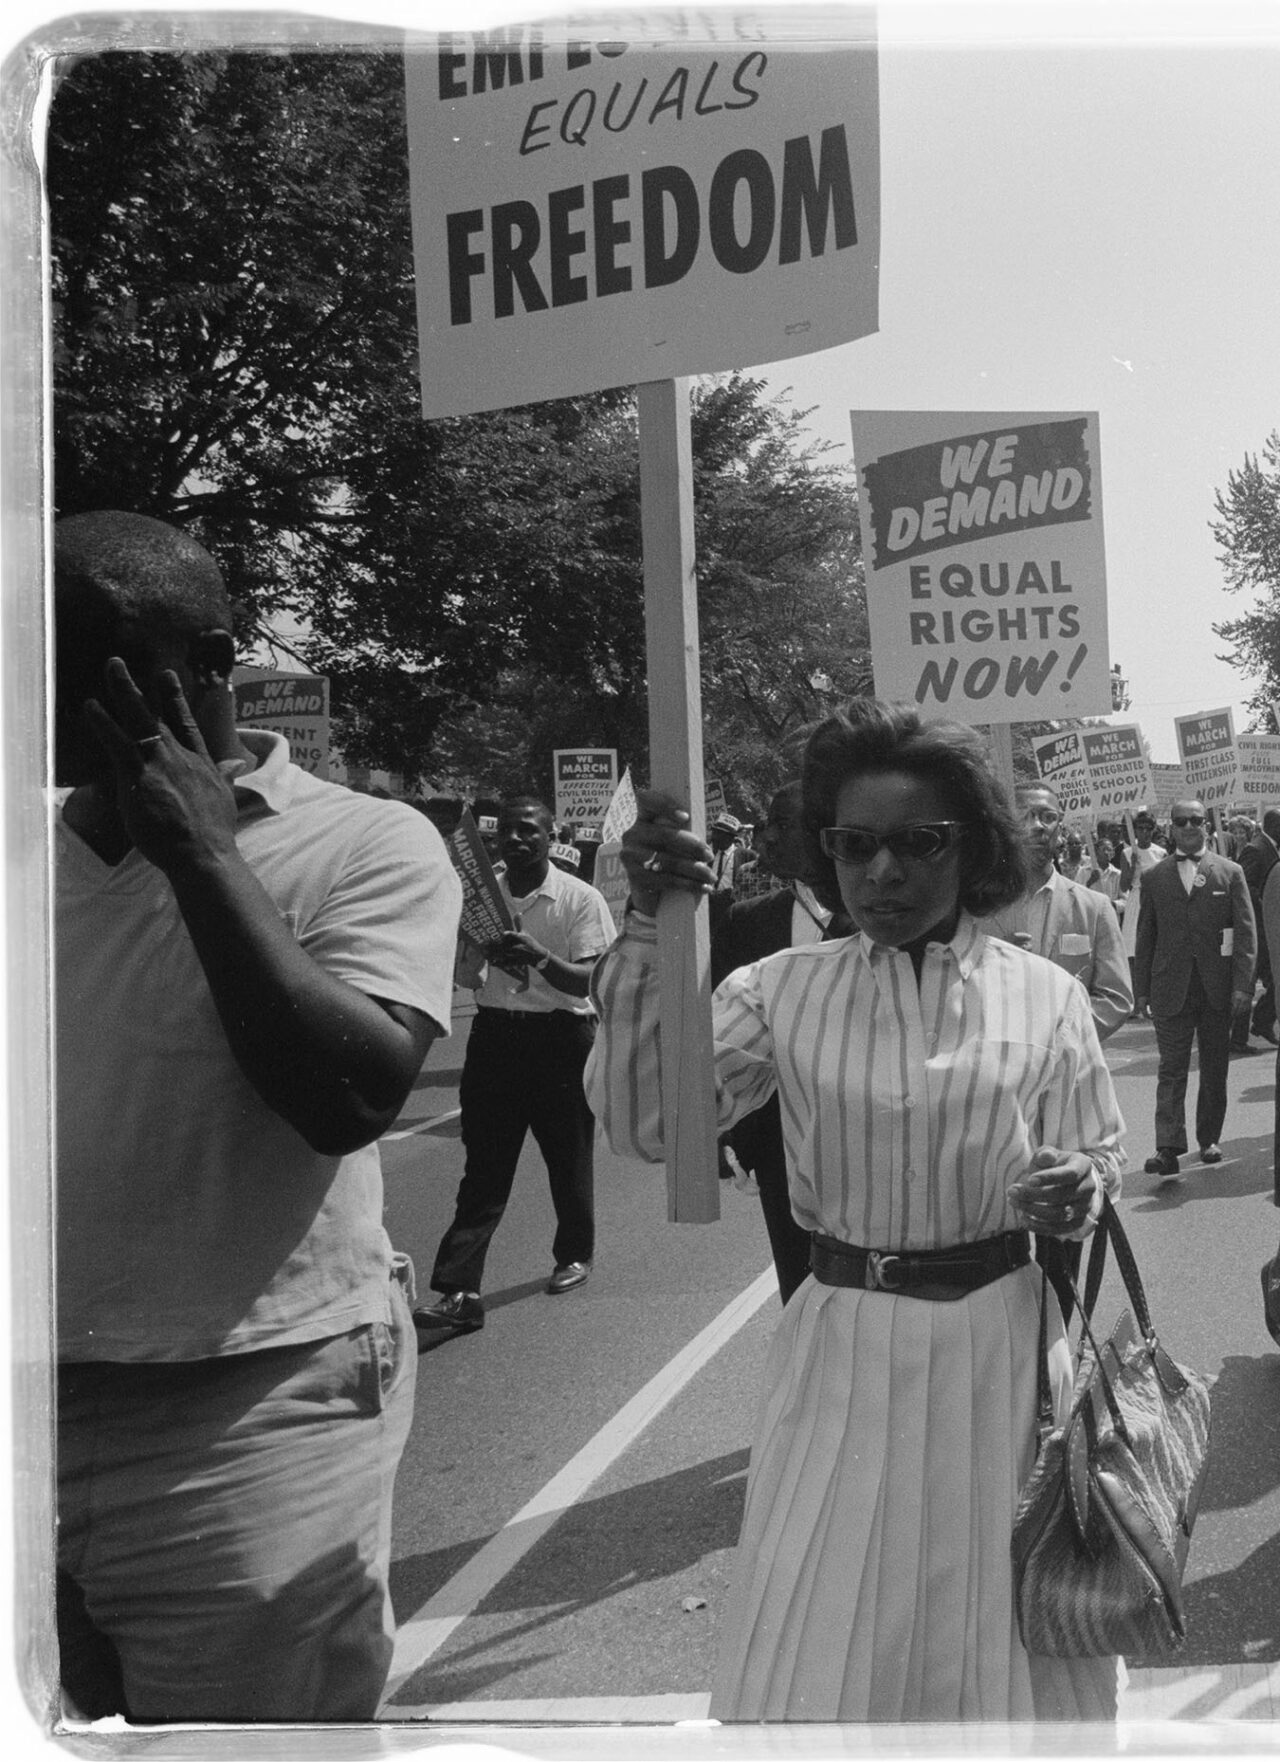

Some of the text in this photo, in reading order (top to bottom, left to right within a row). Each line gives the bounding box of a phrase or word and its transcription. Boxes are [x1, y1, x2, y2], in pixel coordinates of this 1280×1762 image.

[519, 51, 768, 156] EQUALS
[446, 123, 859, 326] FREEDOM
[939, 434, 1019, 489] WE
[886, 466, 1084, 551] DEMAND
[909, 560, 1072, 599] EQUAL
[909, 604, 1080, 646] RIGHTS
[914, 642, 1089, 704] NOW!
[263, 680, 296, 698] WE
[241, 695, 321, 718] DEMAND
[250, 724, 316, 741] CENT
[1198, 719, 1213, 731] WE
[1054, 735, 1077, 754] WE
[1101, 733, 1120, 743] WE
[1186, 727, 1228, 747] MARCH
[1238, 741, 1257, 750] CIVIL
[1089, 740, 1136, 757] MARCH
[1200, 742, 1216, 752] FOR
[576, 755, 594, 763] WE
[1105, 753, 1124, 761] FOR
[1185, 756, 1209, 772] FIRST
[1210, 751, 1235, 766] CLASS
[562, 763, 609, 774] MARCH
[1050, 771, 1067, 782] AN
[1089, 760, 1144, 778] INTEGRATED
[1185, 763, 1238, 785] CITIZENSHIP
[562, 782, 610, 790] EFFECTIVE
[1061, 780, 1089, 791] POLICE
[1092, 773, 1147, 791] SCHOOLS
[1196, 778, 1236, 801] NOW!
[557, 789, 614, 798] CIVIL RIGHTS
[572, 797, 600, 805] LAWS
[1100, 785, 1147, 807] NOW!
[453, 827, 480, 879] MARCH
[477, 884, 505, 932] WASHINGT
